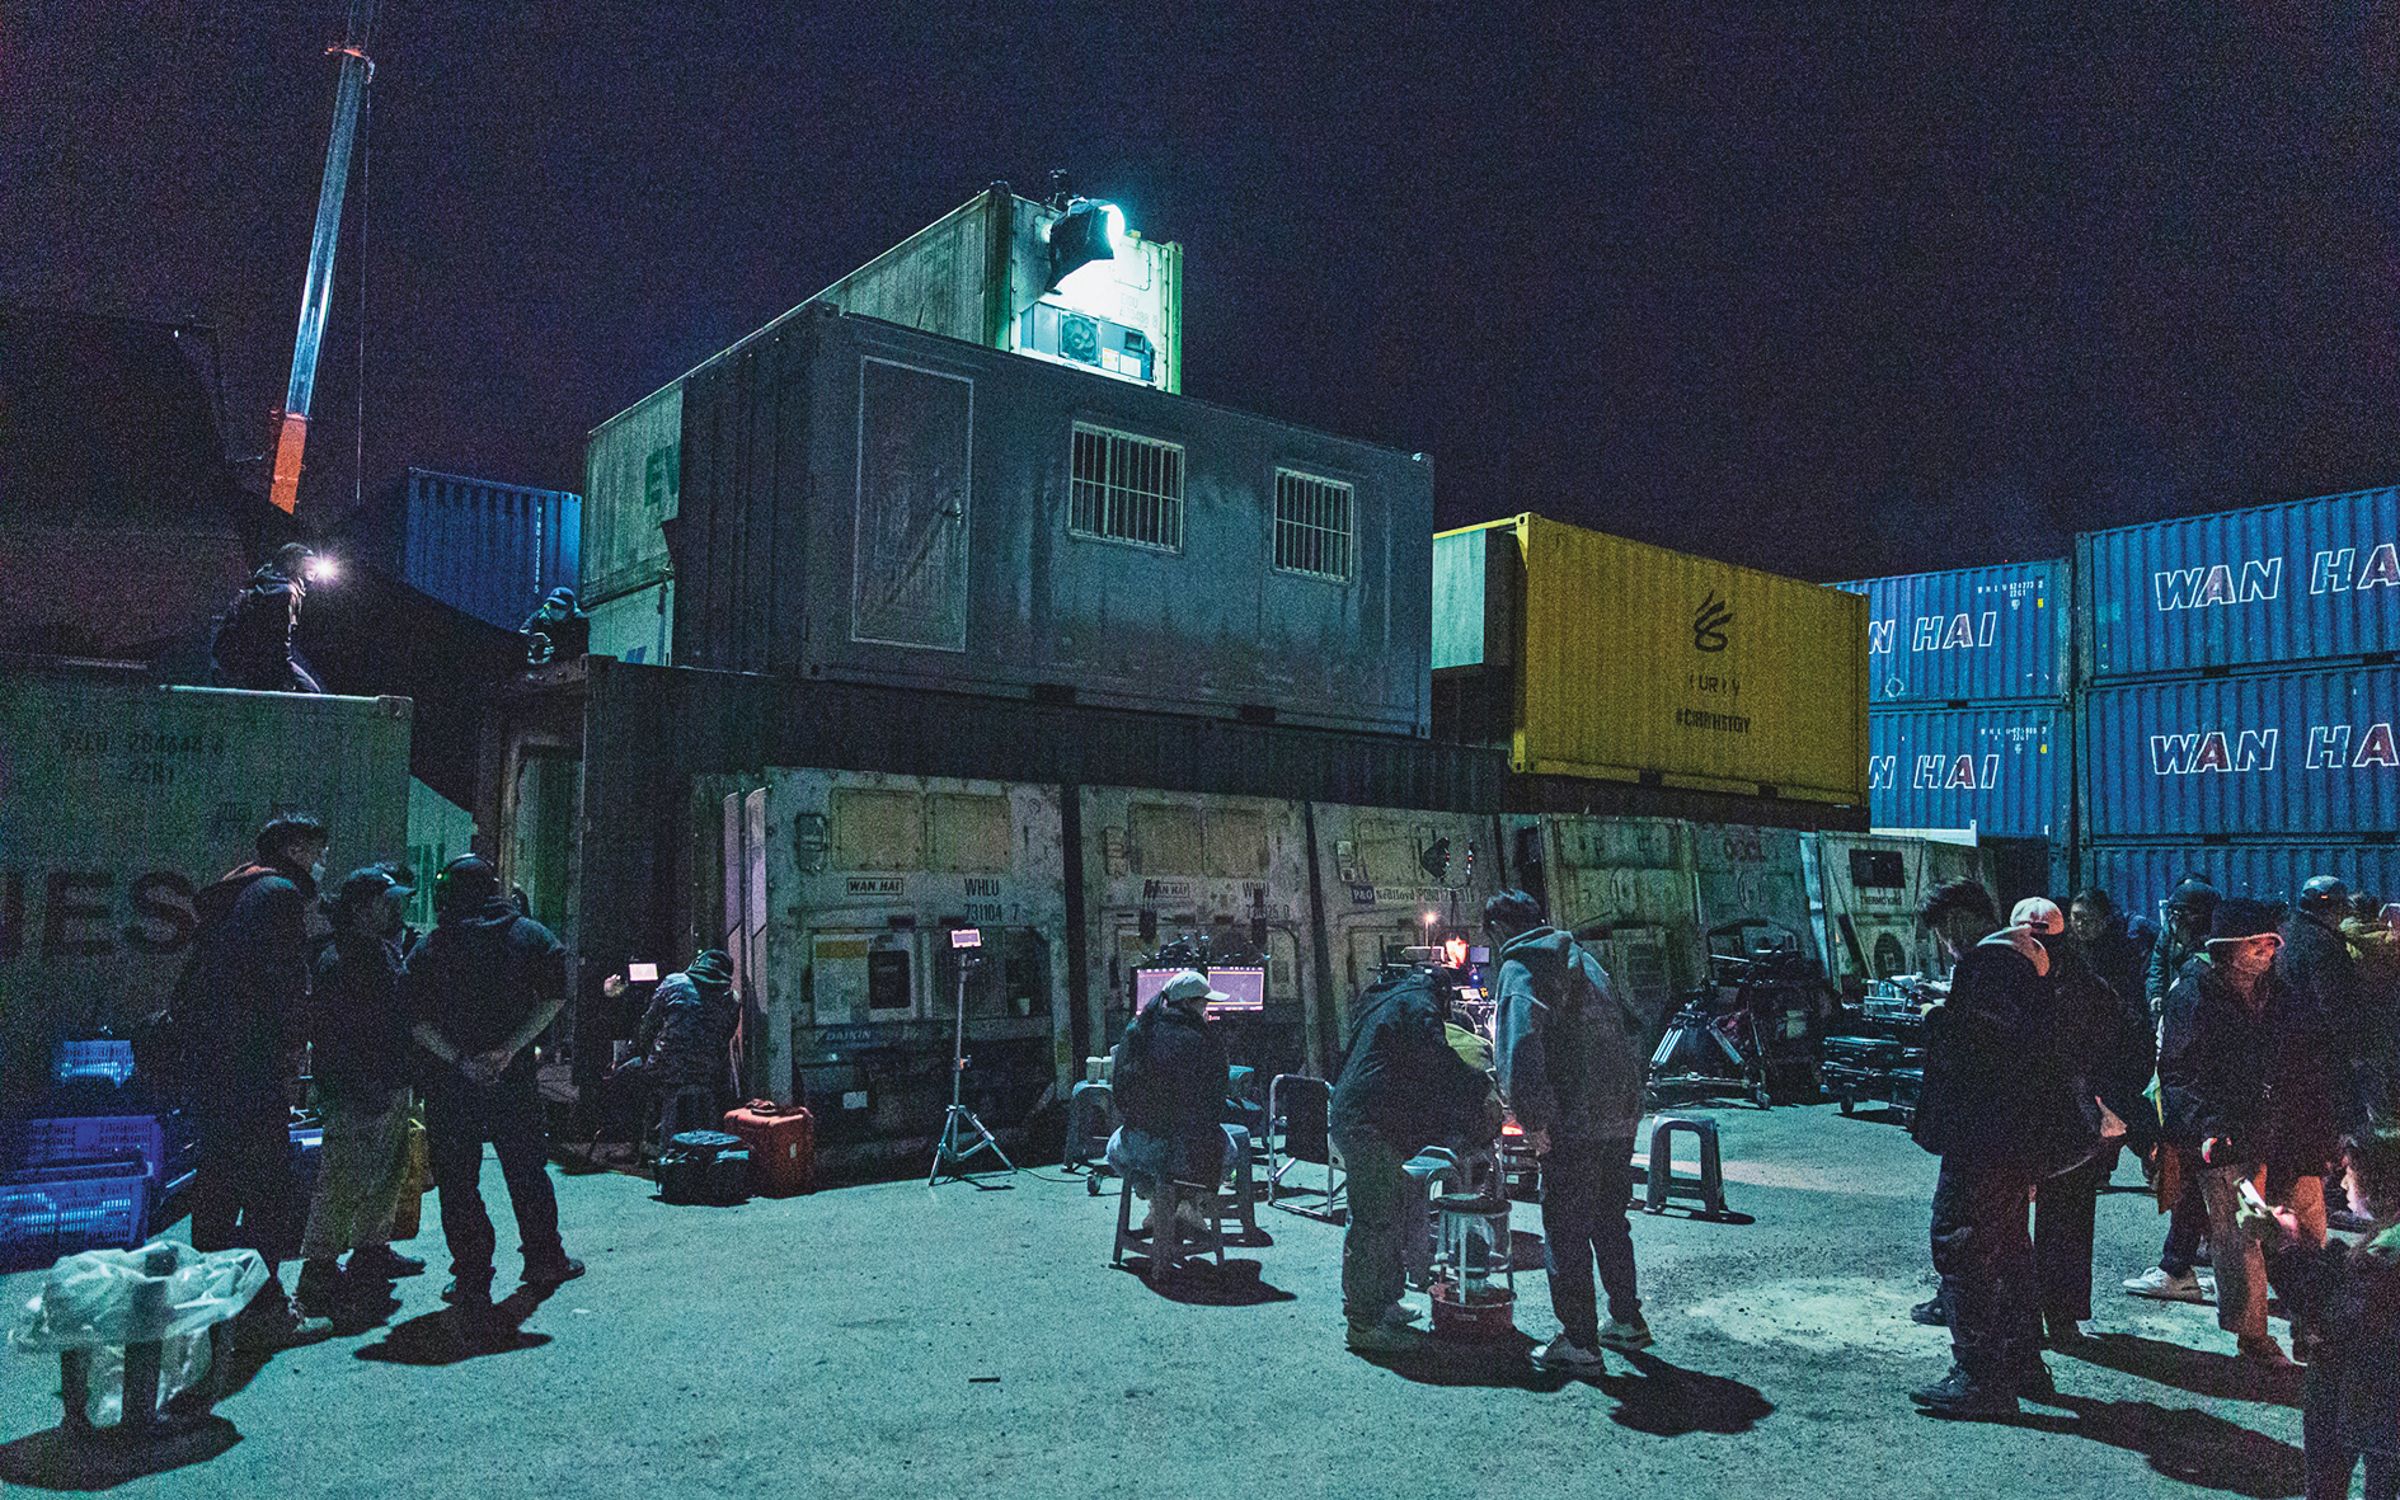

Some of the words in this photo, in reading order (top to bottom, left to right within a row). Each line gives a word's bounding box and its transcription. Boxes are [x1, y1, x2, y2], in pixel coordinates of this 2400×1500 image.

[2154, 556, 2282, 612] WAN
[2310, 542, 2400, 595] HA
[1912, 611, 1997, 652] HAI
[2150, 728, 2278, 776] WAN
[2306, 722, 2400, 769] HA
[1913, 754, 2000, 790] HAI
[848, 880, 877, 893] WAN
[879, 880, 900, 893] HAI
[964, 878, 1000, 897] WHLU
[964, 903, 1002, 922] 731104
[1012, 903, 1020, 921] 7
